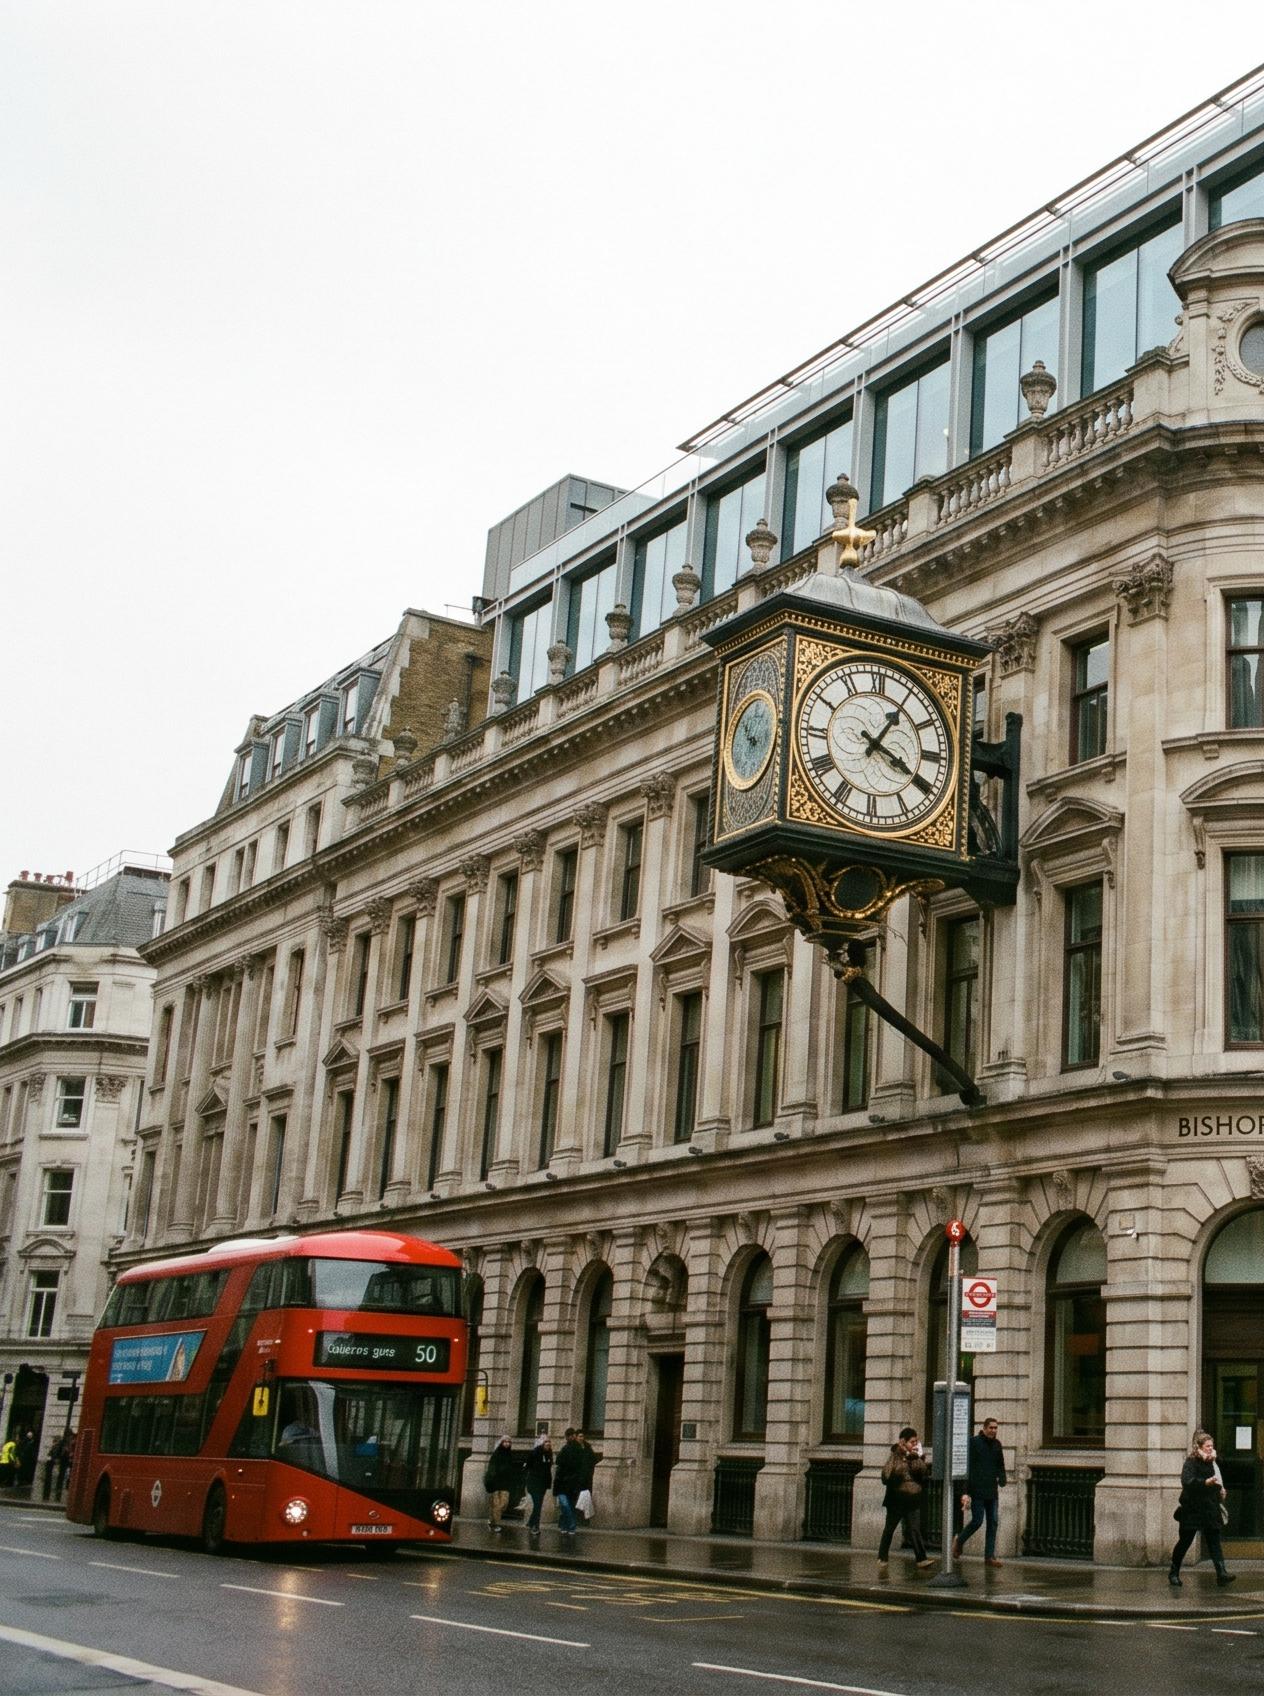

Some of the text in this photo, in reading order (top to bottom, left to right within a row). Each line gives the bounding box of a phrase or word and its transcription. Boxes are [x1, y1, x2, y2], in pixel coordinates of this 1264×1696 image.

[841, 675, 858, 696] XI
[870, 673, 886, 695] XII
[901, 690, 913, 708] I
[808, 724, 829, 741] IX
[916, 717, 936, 732] II
[920, 748, 942, 764] III
[834, 780, 852, 803] VII
[866, 794, 878, 816] VI
[896, 792, 910, 815] V
[415, 1344, 437, 1364] 50
